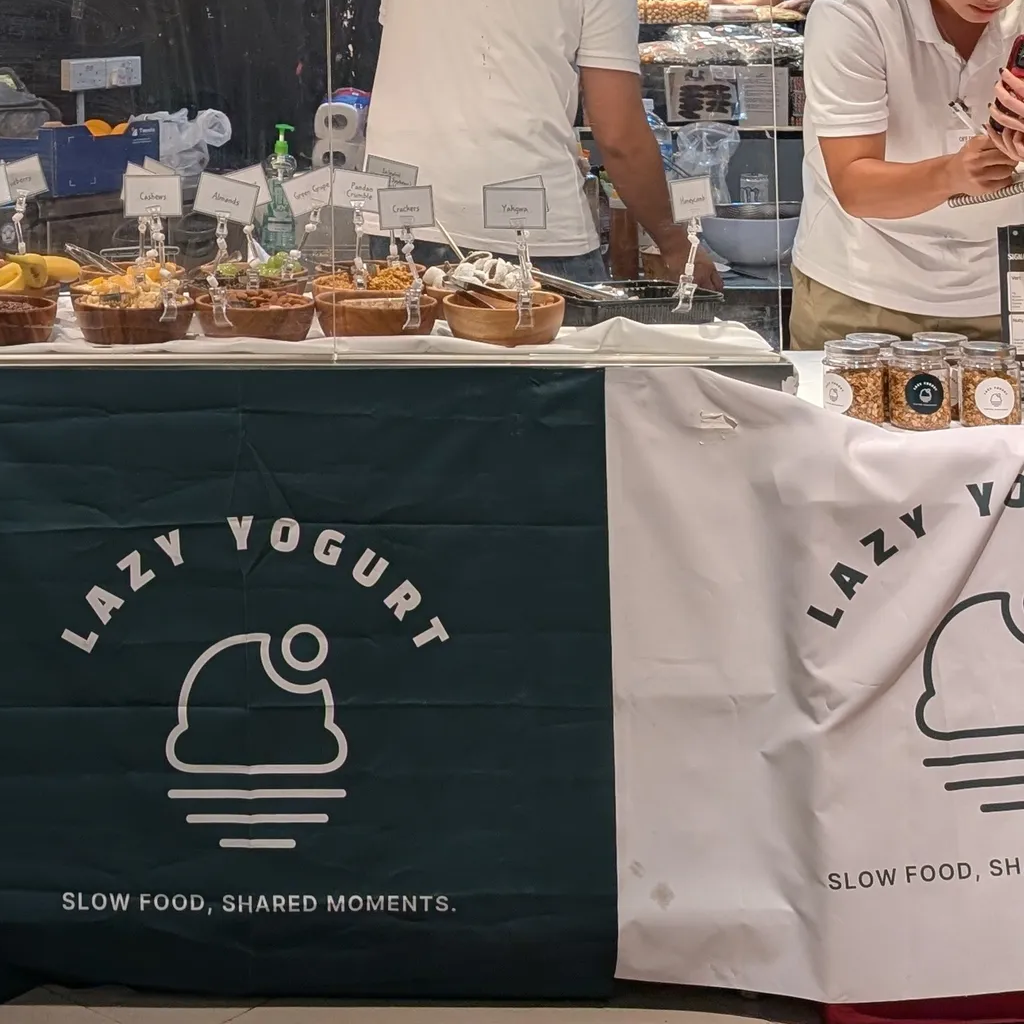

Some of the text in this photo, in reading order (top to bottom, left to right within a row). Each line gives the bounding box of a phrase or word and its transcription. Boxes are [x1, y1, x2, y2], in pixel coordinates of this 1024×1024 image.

[346, 190, 373, 201] Crumble
[350, 182, 374, 193] Pandan
[139, 191, 167, 202] Cashews
[211, 191, 241, 207] Almonds
[392, 204, 420, 214] Crackers
[806, 504, 928, 630] LAZY
[60, 515, 452, 655] LAZY YOGURT
[827, 867, 898, 891] SLOW
[905, 862, 982, 884] FOOD,
[61, 890, 458, 917] SLOW FOOD, SHARED MOMENTS.
